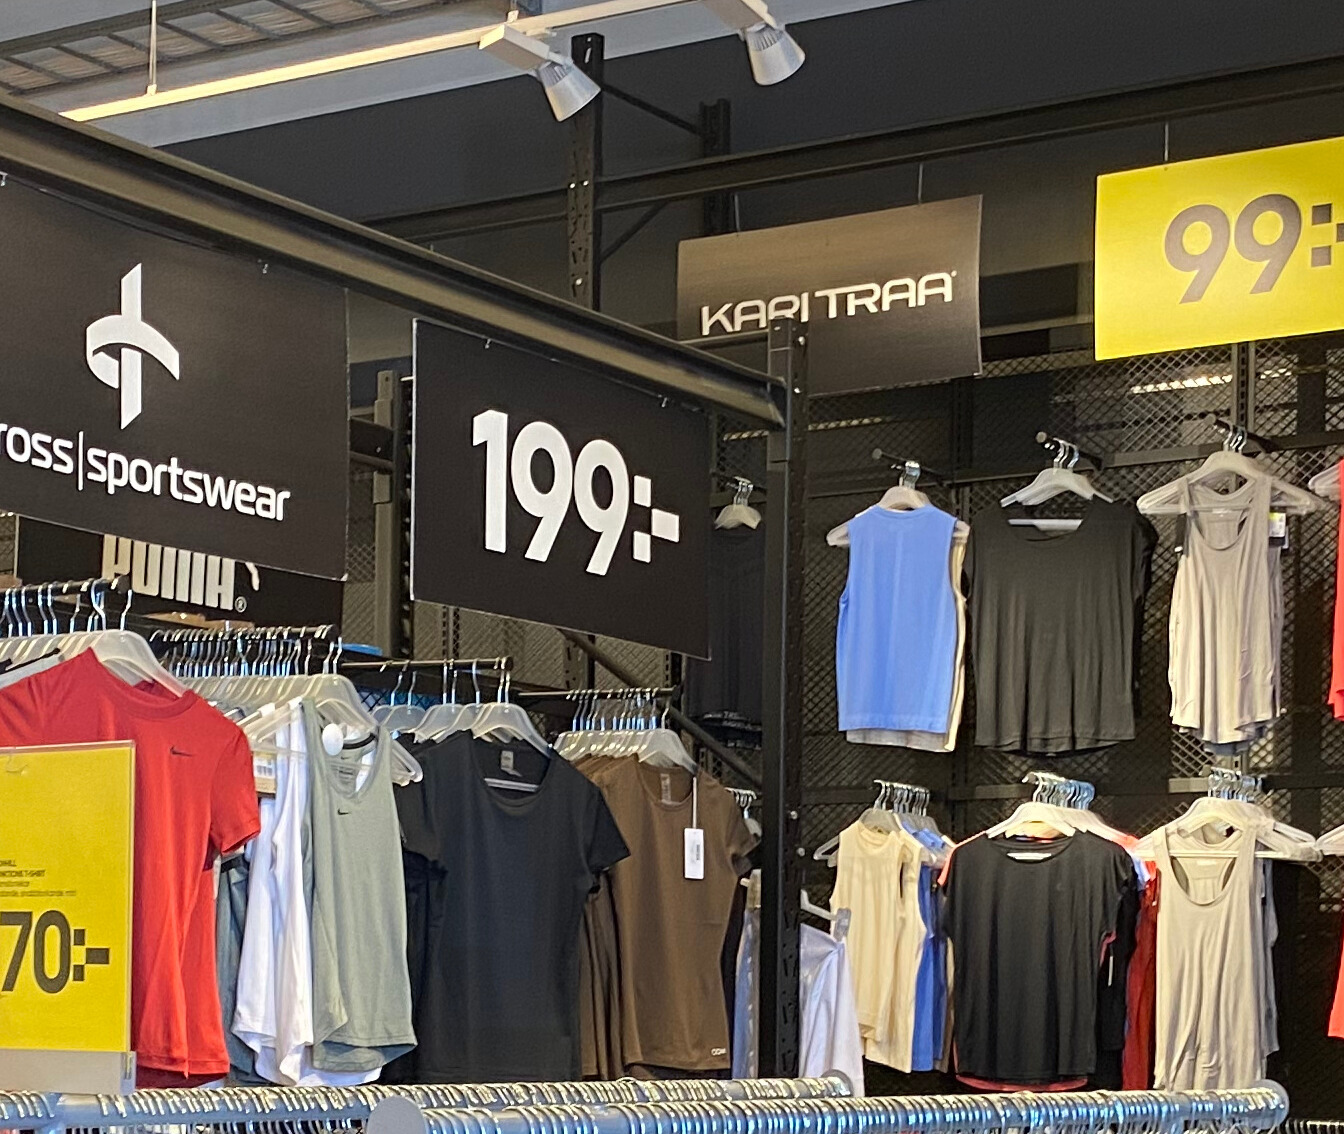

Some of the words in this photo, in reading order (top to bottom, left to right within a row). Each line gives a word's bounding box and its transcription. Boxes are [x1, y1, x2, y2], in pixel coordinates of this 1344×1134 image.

[700, 289, 809, 336] KARI
[815, 272, 954, 320] TRAA
[471, 408, 680, 577] 199:-
[0, 909, 110, 994] 70:-
